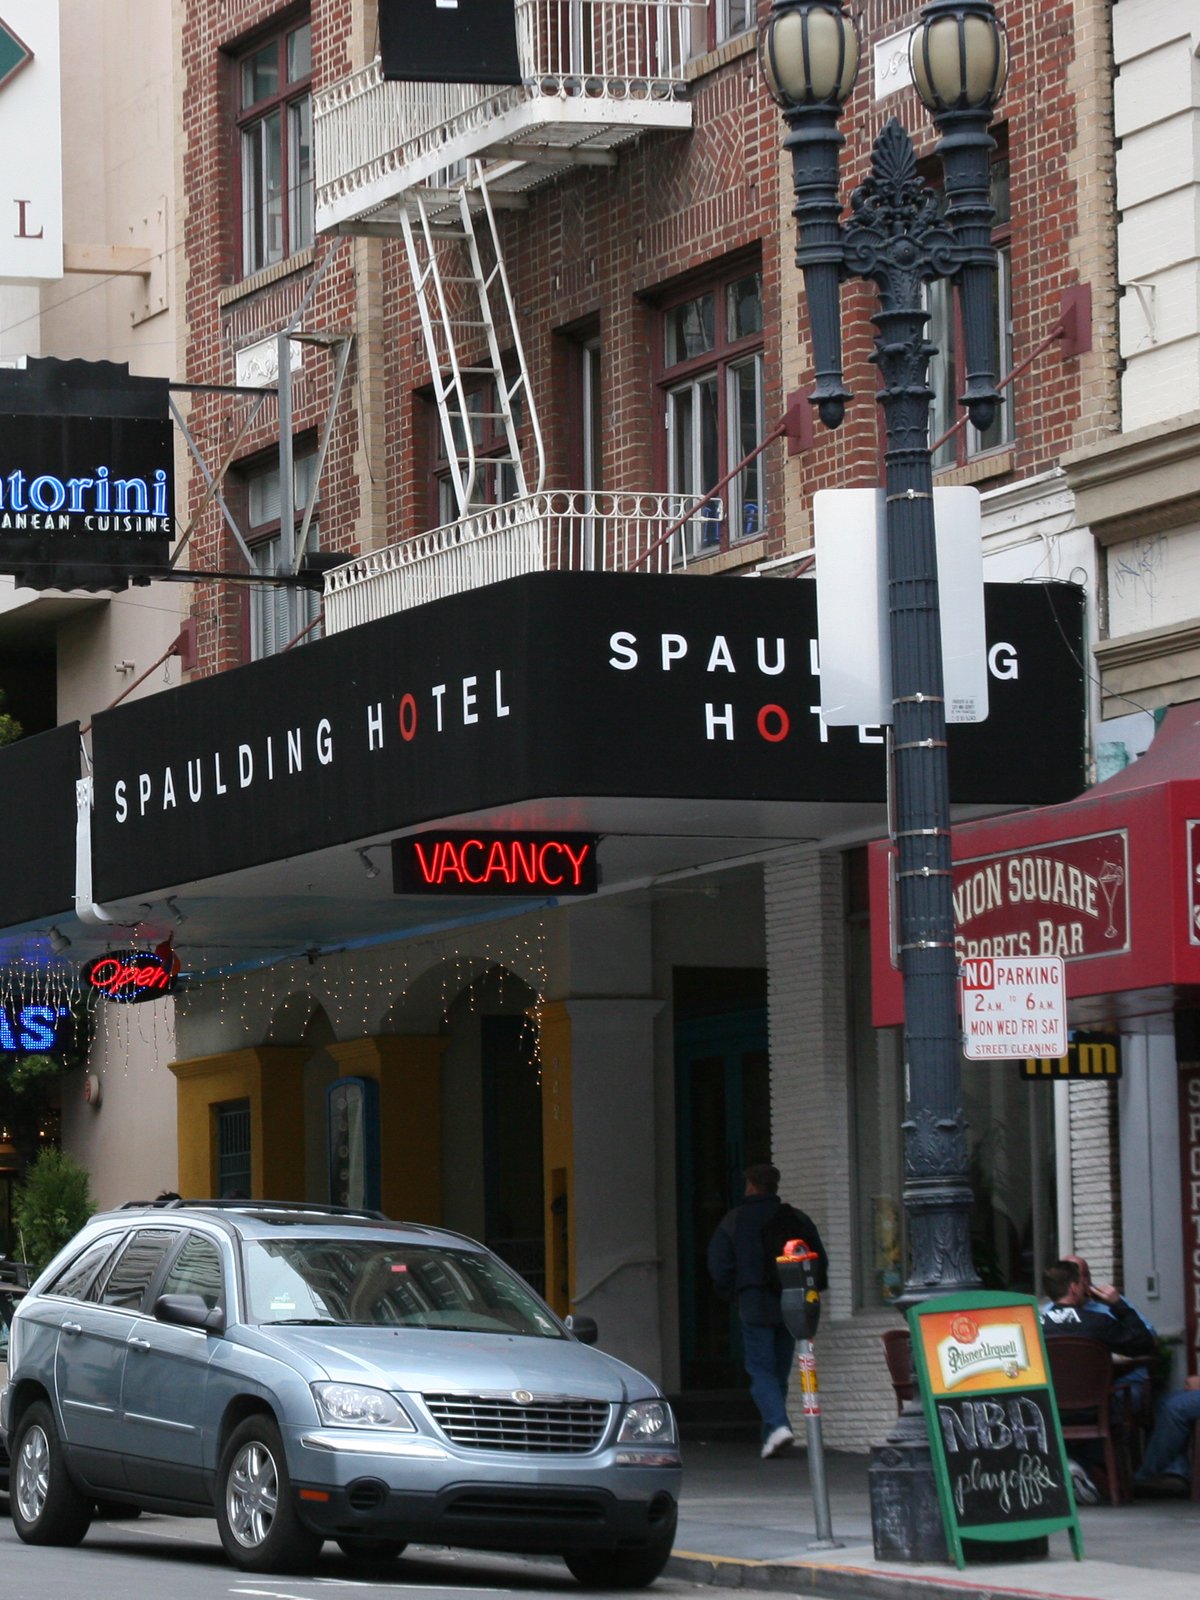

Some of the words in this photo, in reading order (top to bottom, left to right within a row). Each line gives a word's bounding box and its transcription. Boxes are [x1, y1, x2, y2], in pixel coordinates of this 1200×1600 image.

[84, 515, 171, 534] CUISINE
[609, 631, 1019, 681] SPAULG
[705, 703, 885, 744] HOT
[114, 718, 333, 824] SPAULDING
[367, 669, 511, 752] HOTEL
[414, 839, 590, 887] VACANCY
[952, 863, 1002, 925] NION
[1008, 857, 1099, 918] SQUARE
[955, 932, 1031, 959] SPORTS
[1039, 920, 1084, 956] BAR
[90, 959, 170, 989] Open
[966, 961, 993, 988] NO
[997, 966, 1059, 986] PARKING
[974, 993, 986, 1012] 2
[1025, 992, 1036, 1011] 6
[971, 1020, 994, 1036] MON
[996, 1019, 1018, 1035] WED
[1020, 1018, 1038, 1035] FRI
[1041, 1018, 1059, 1034] SAT
[975, 1044, 1008, 1055] STREET
[1011, 1043, 1058, 1054] CLEANING
[947, 1345, 984, 1374] Pilsner
[980, 1339, 1018, 1361] Urquell
[939, 1397, 1048, 1453] NBA
